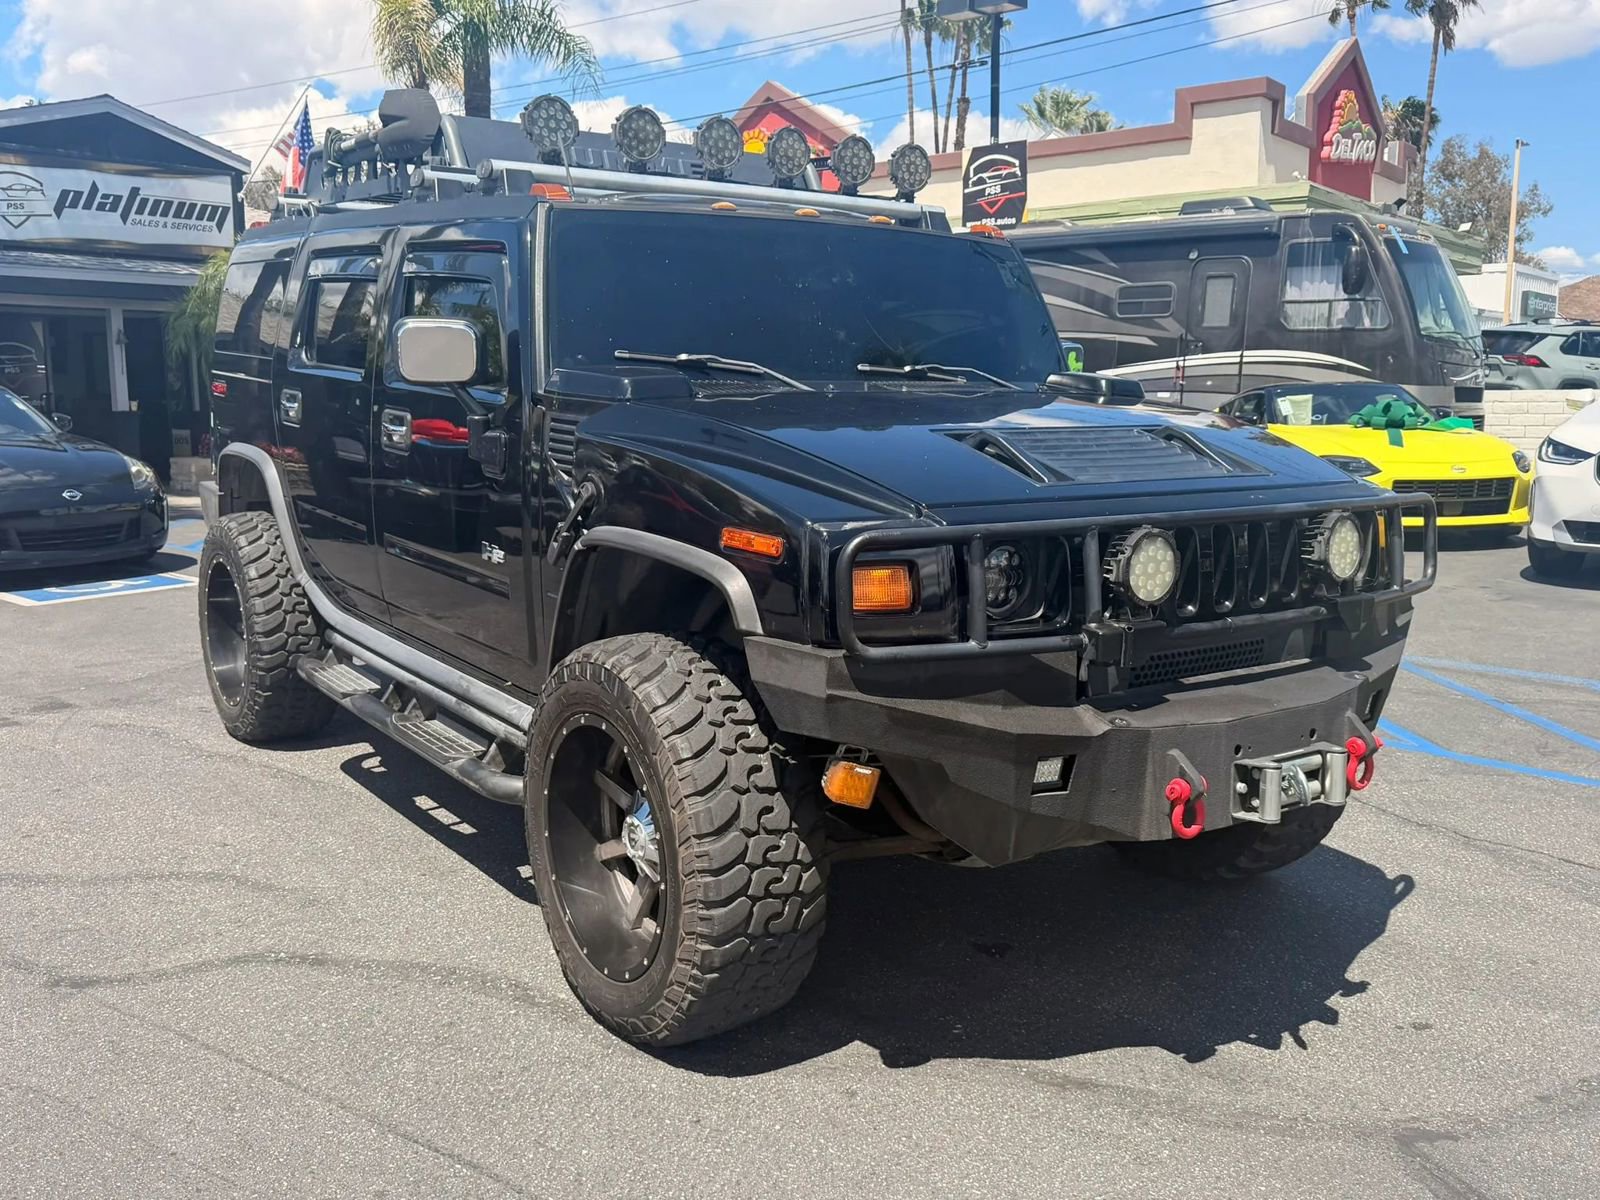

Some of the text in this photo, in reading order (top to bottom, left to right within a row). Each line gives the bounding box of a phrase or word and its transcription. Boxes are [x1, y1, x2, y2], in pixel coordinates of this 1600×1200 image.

[985, 185, 1001, 195] PSS
[6, 202, 25, 210] PSS
[53, 180, 230, 233] platinum
[130, 217, 160, 228] SALES
[170, 222, 213, 233] SERVICES
